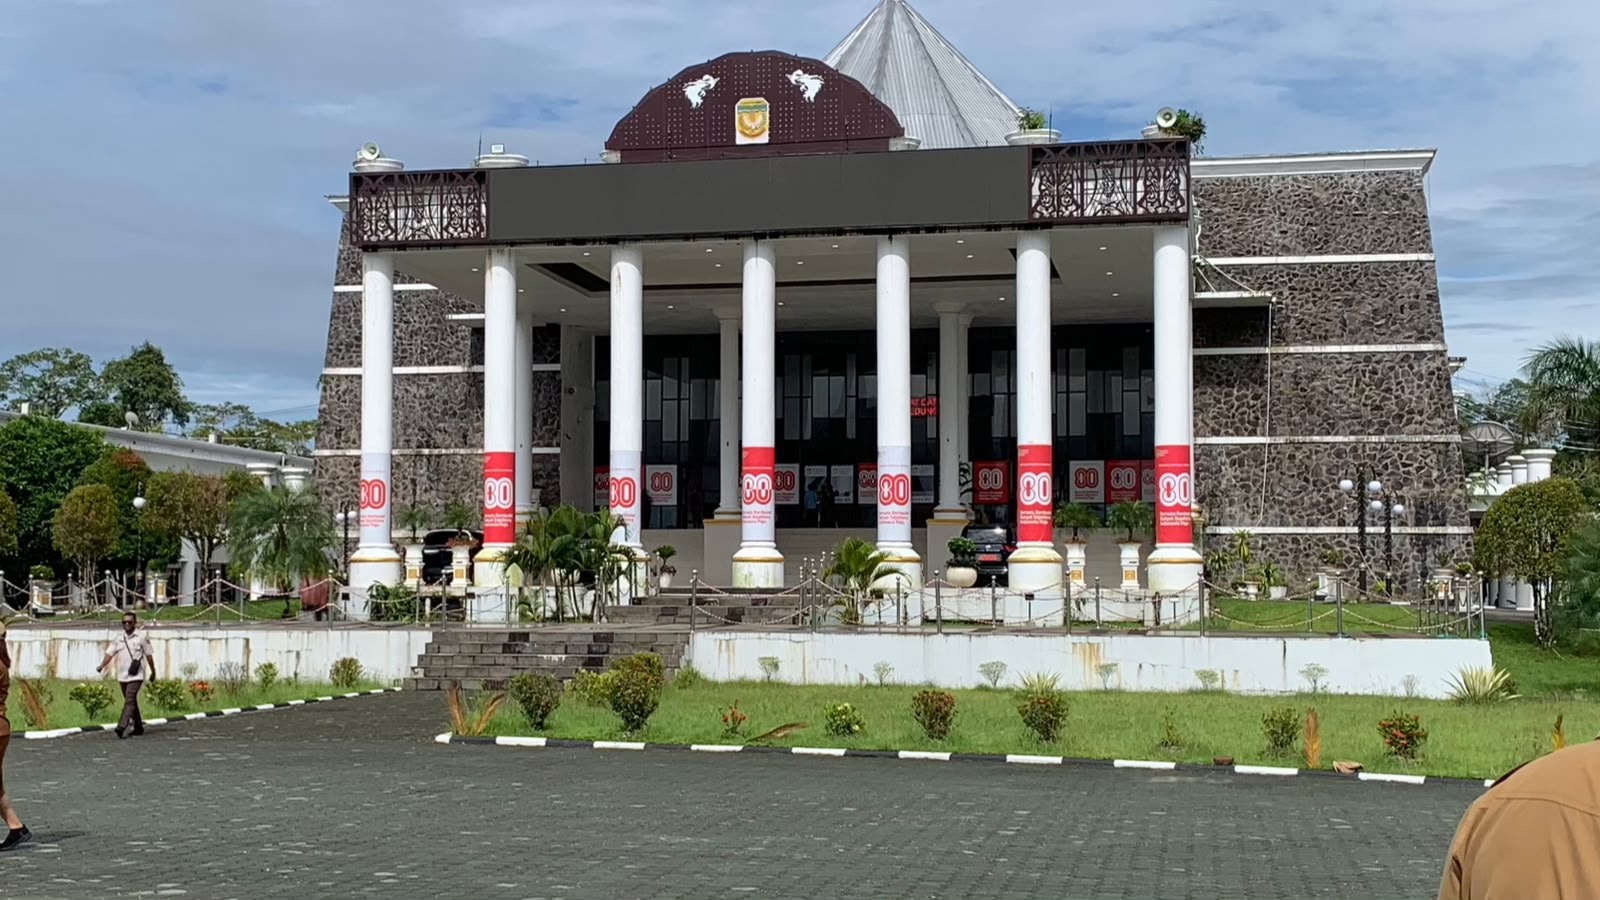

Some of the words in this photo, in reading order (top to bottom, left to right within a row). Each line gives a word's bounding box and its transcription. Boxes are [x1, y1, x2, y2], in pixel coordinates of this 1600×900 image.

[485, 477, 513, 509] 80
[651, 472, 673, 492] 80
[743, 473, 772, 505] 80
[879, 473, 909, 506] 80
[979, 468, 1003, 490] 80
[1020, 472, 1051, 506] 80
[1074, 468, 1098, 488] 80
[1111, 467, 1136, 489] 80
[1159, 472, 1191, 507] 80
